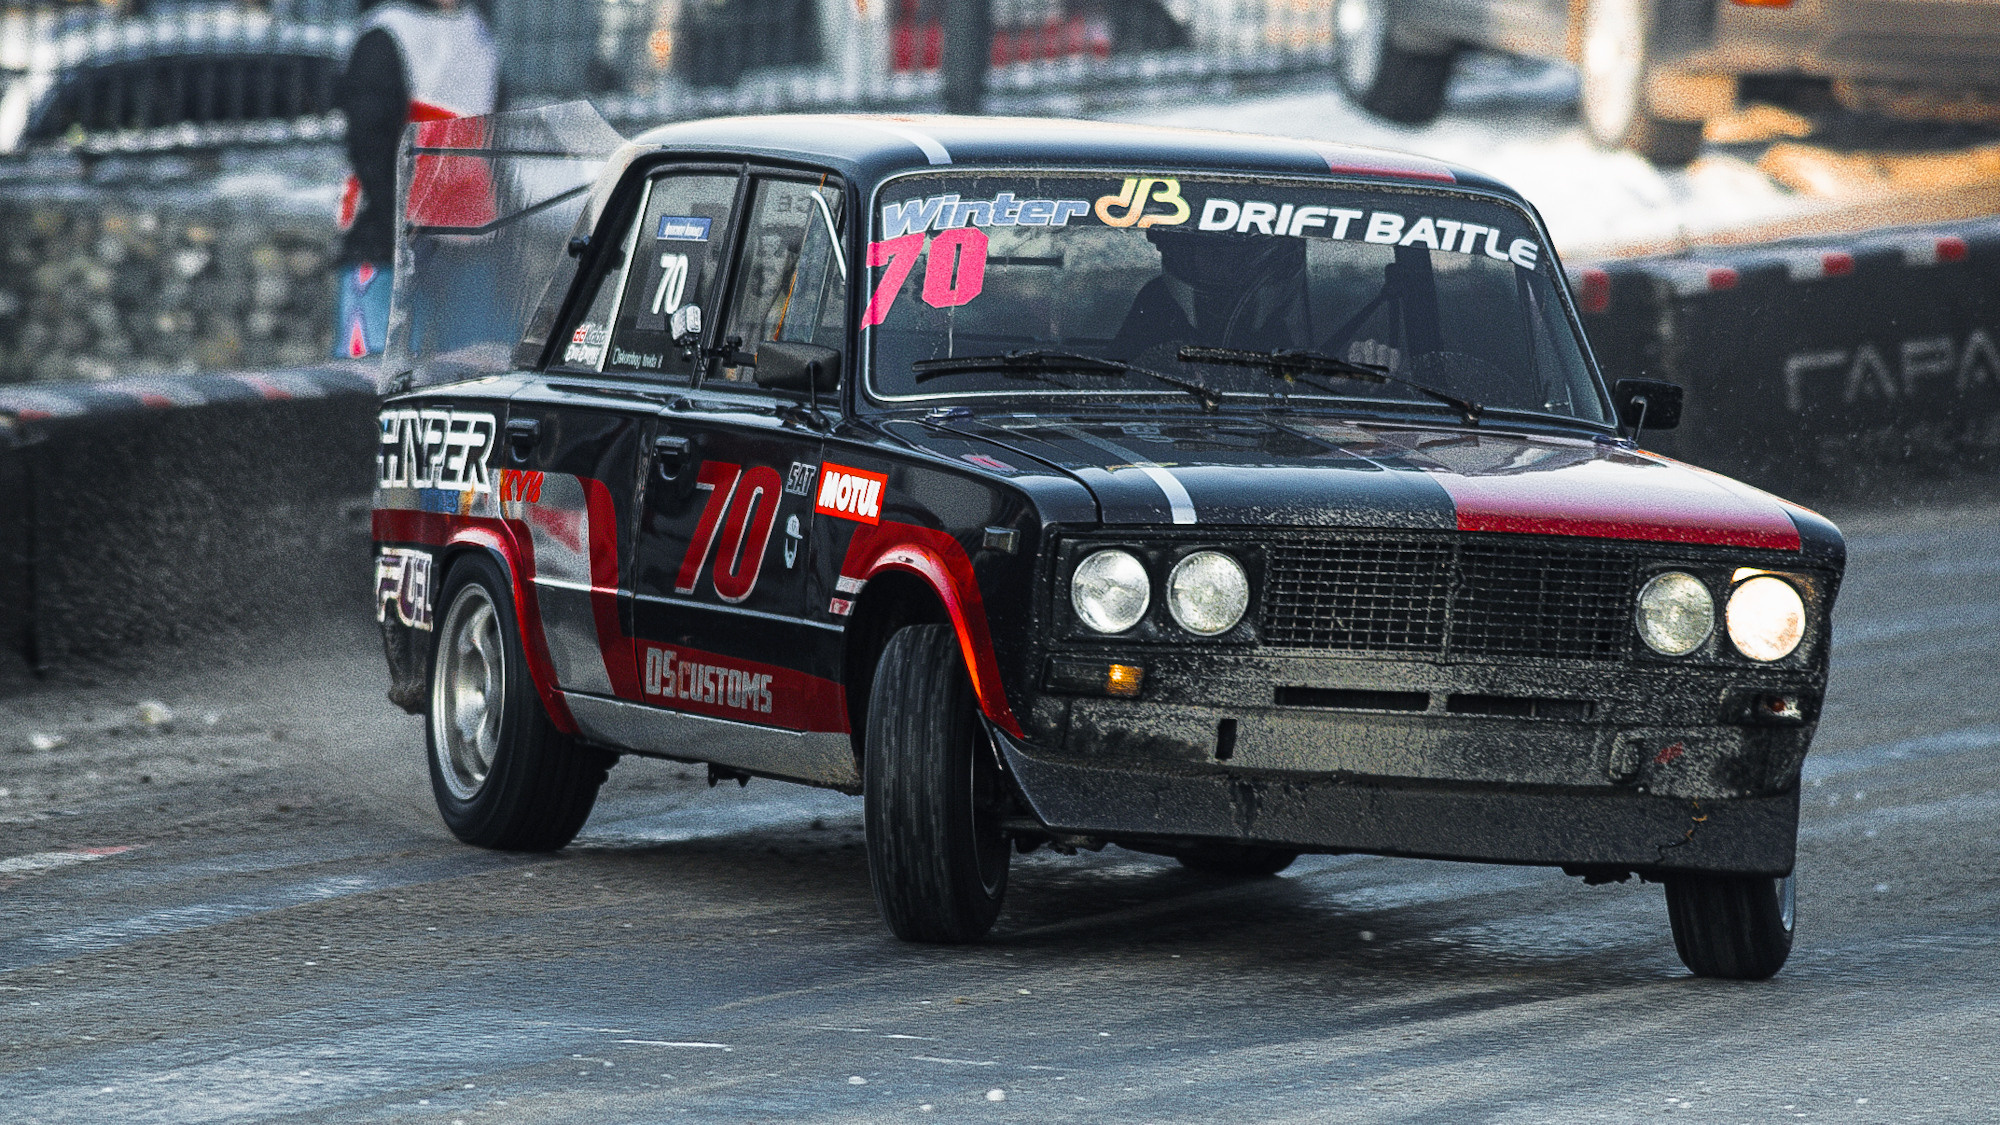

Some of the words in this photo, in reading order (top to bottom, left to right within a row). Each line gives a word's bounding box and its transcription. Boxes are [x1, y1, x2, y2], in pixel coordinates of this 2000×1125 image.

[882, 192, 1090, 240] Winter
[1198, 198, 1362, 240] DRIFT
[1365, 211, 1539, 271] BATTLE
[650, 252, 689, 315] 70
[861, 227, 989, 331] 70
[376, 409, 496, 493] HYPER
[500, 469, 544, 503] KYB
[785, 461, 817, 497] SAT
[674, 460, 783, 603] 70
[818, 470, 882, 518] MOTUL
[375, 546, 434, 633] FUEL
